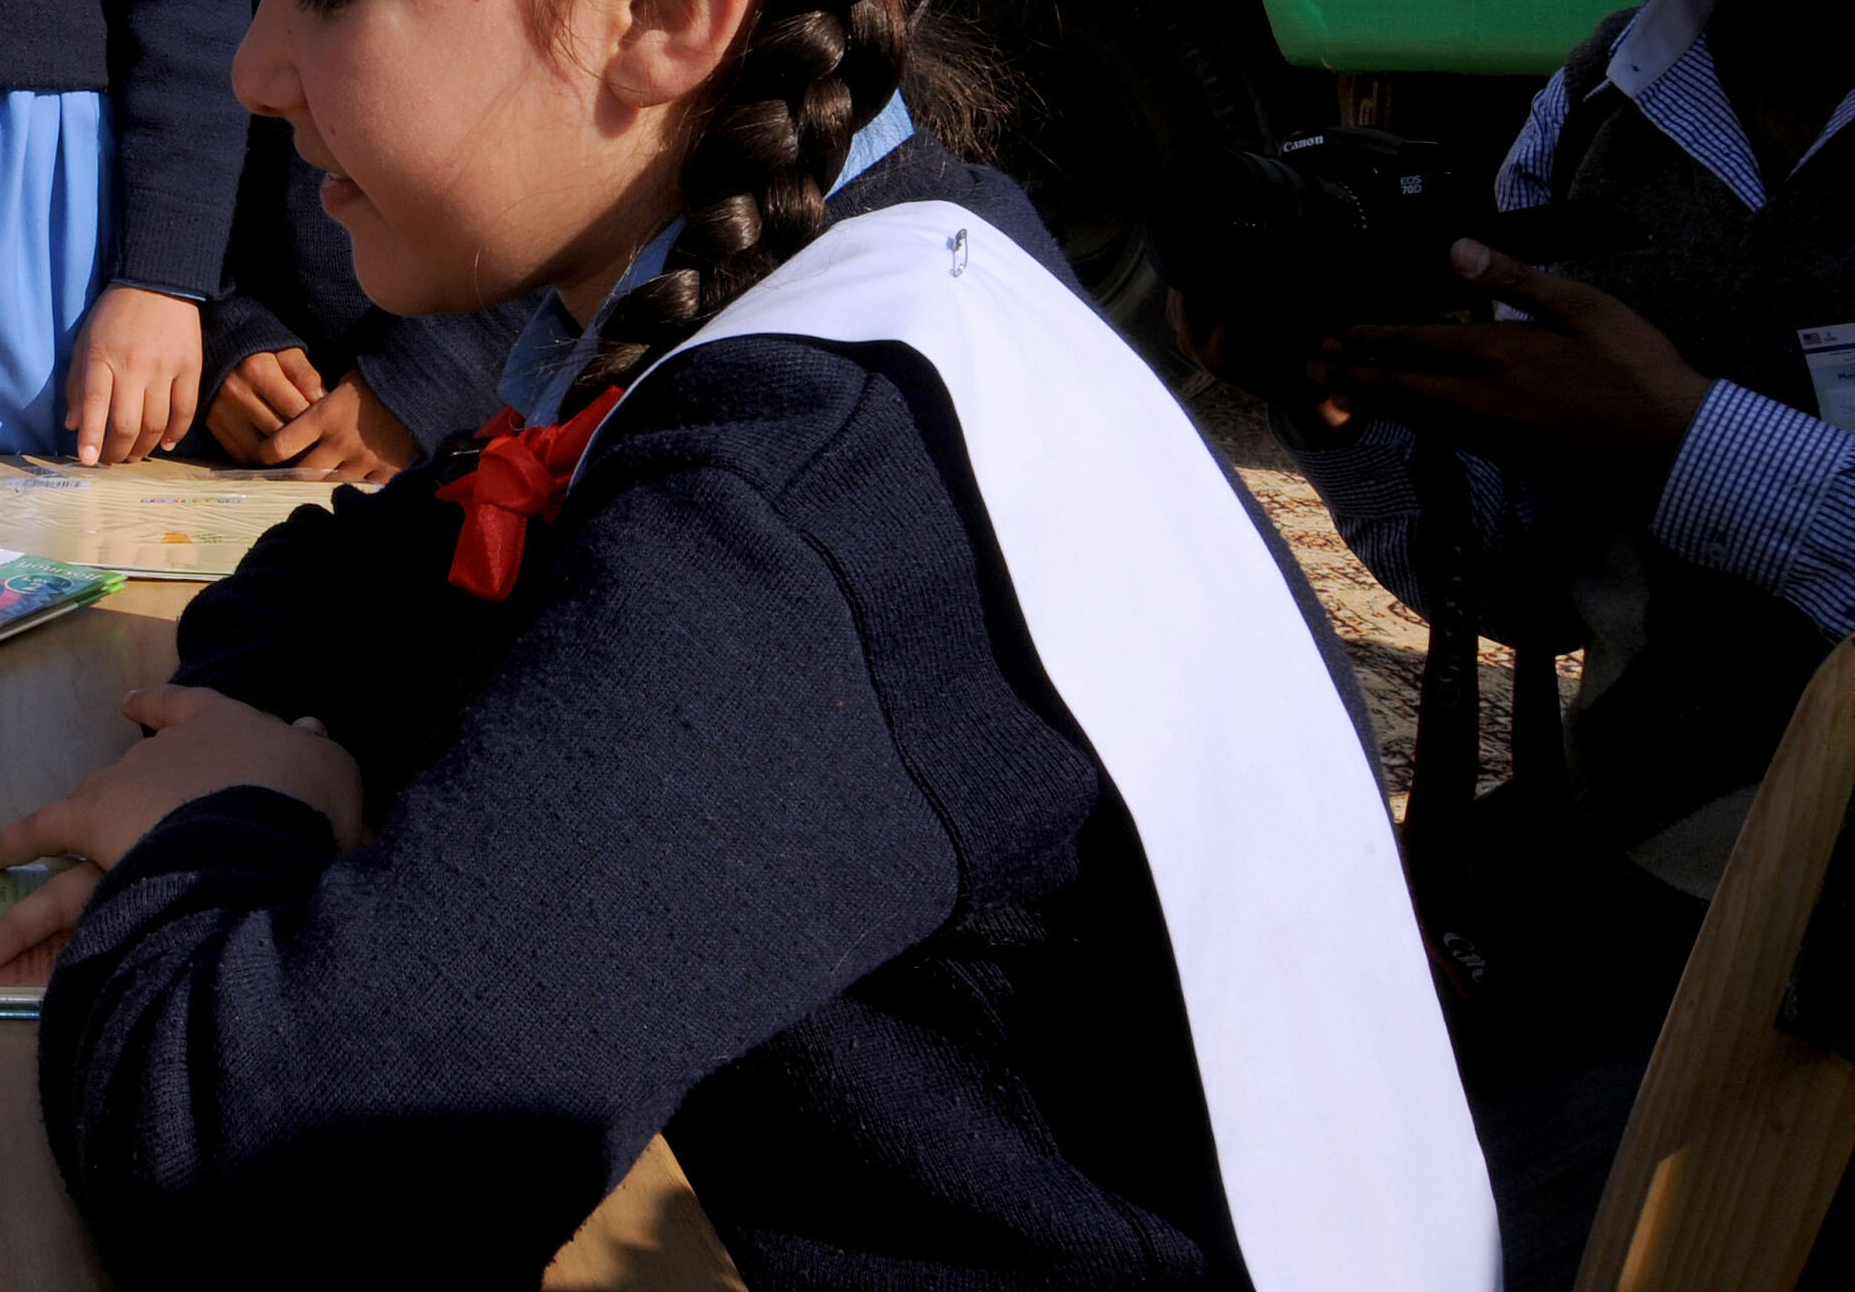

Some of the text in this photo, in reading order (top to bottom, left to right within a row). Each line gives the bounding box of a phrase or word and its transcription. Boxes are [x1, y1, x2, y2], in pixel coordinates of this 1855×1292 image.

[1283, 135, 1324, 153] Canon
[1400, 175, 1422, 185] EOS
[1401, 185, 1423, 195] 70D
